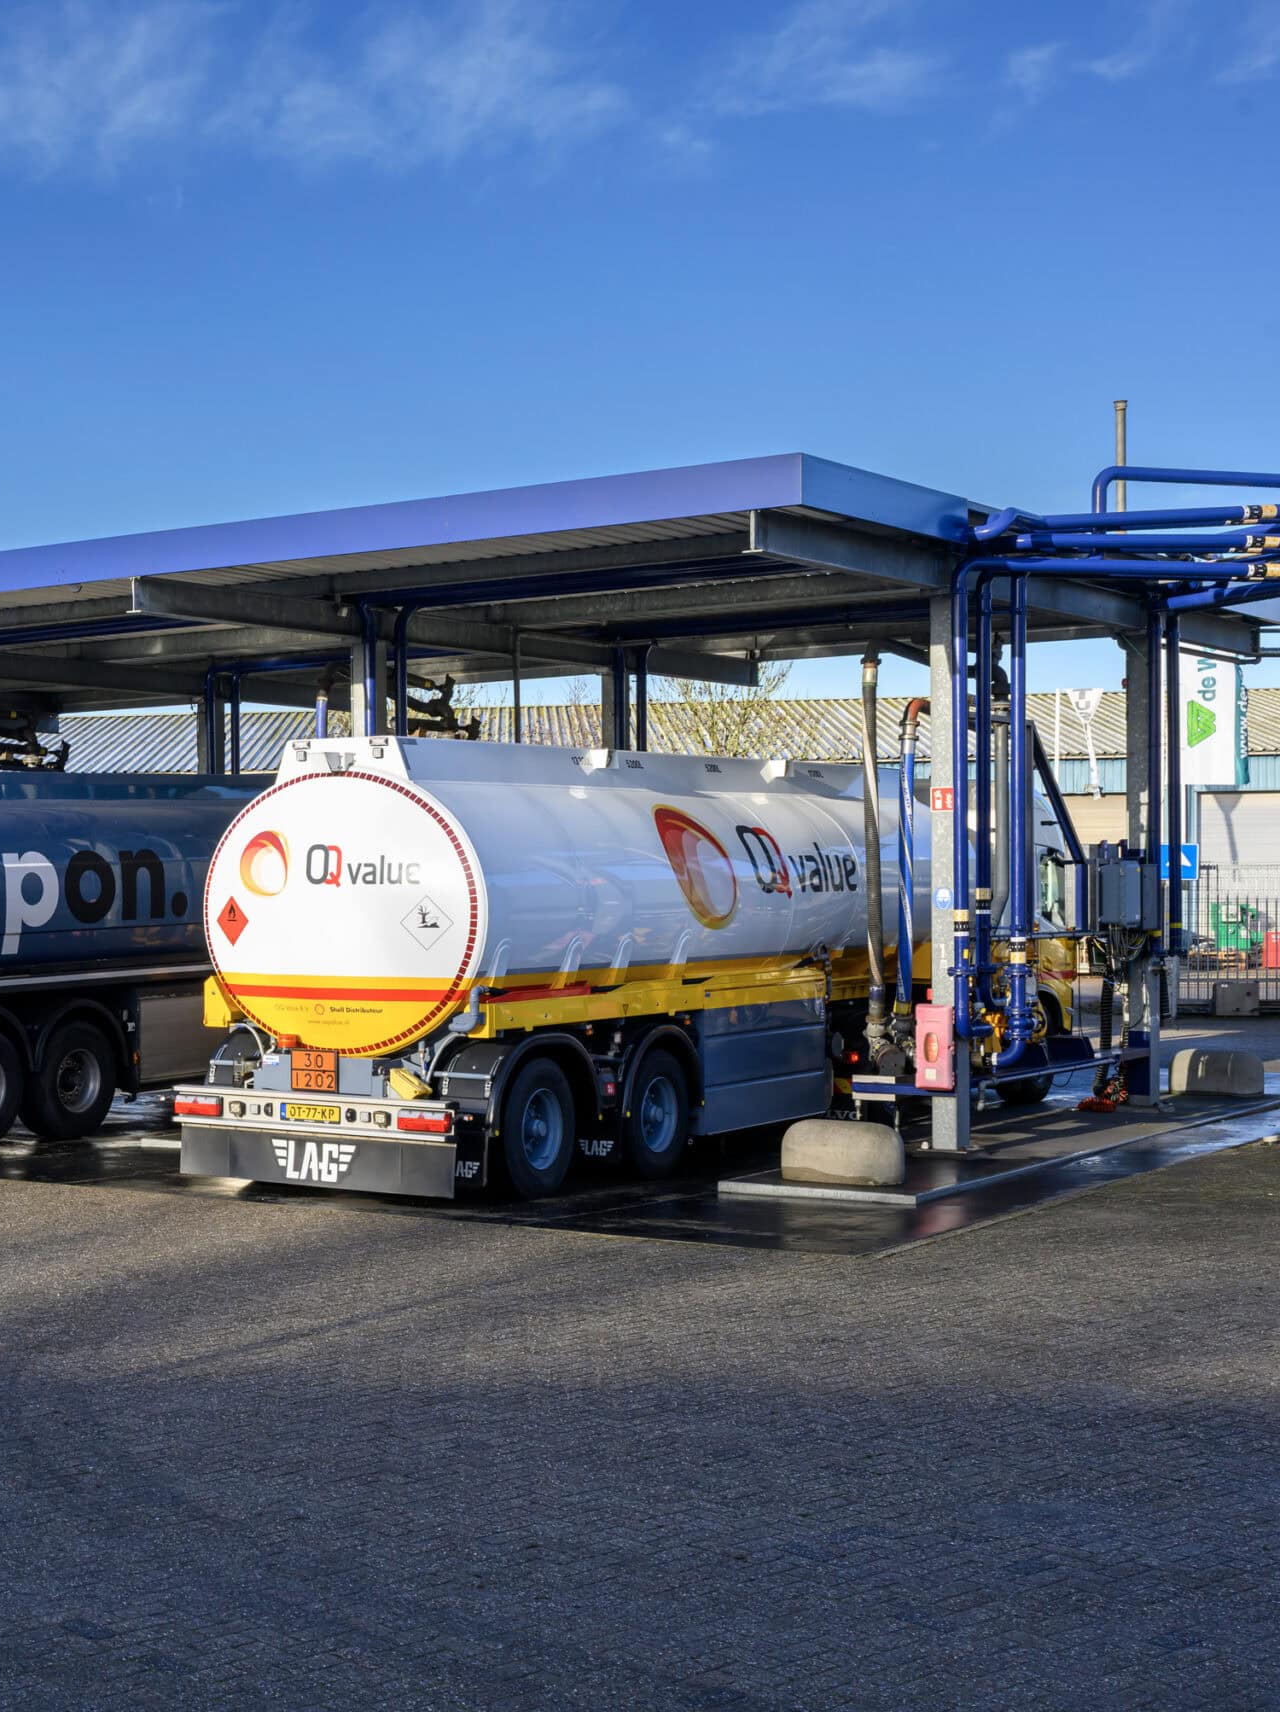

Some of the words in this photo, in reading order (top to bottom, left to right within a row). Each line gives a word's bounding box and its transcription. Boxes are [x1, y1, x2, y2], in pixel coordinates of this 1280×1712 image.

[1198, 677, 1216, 702] de
[347, 855, 420, 885] value
[788, 842, 857, 893] value
[304, 1053, 324, 1069] 30
[296, 1072, 334, 1089] 1202
[290, 1108, 335, 1120] OT-77-KP
[285, 1140, 339, 1183] LAG
[455, 1161, 474, 1178] AG
